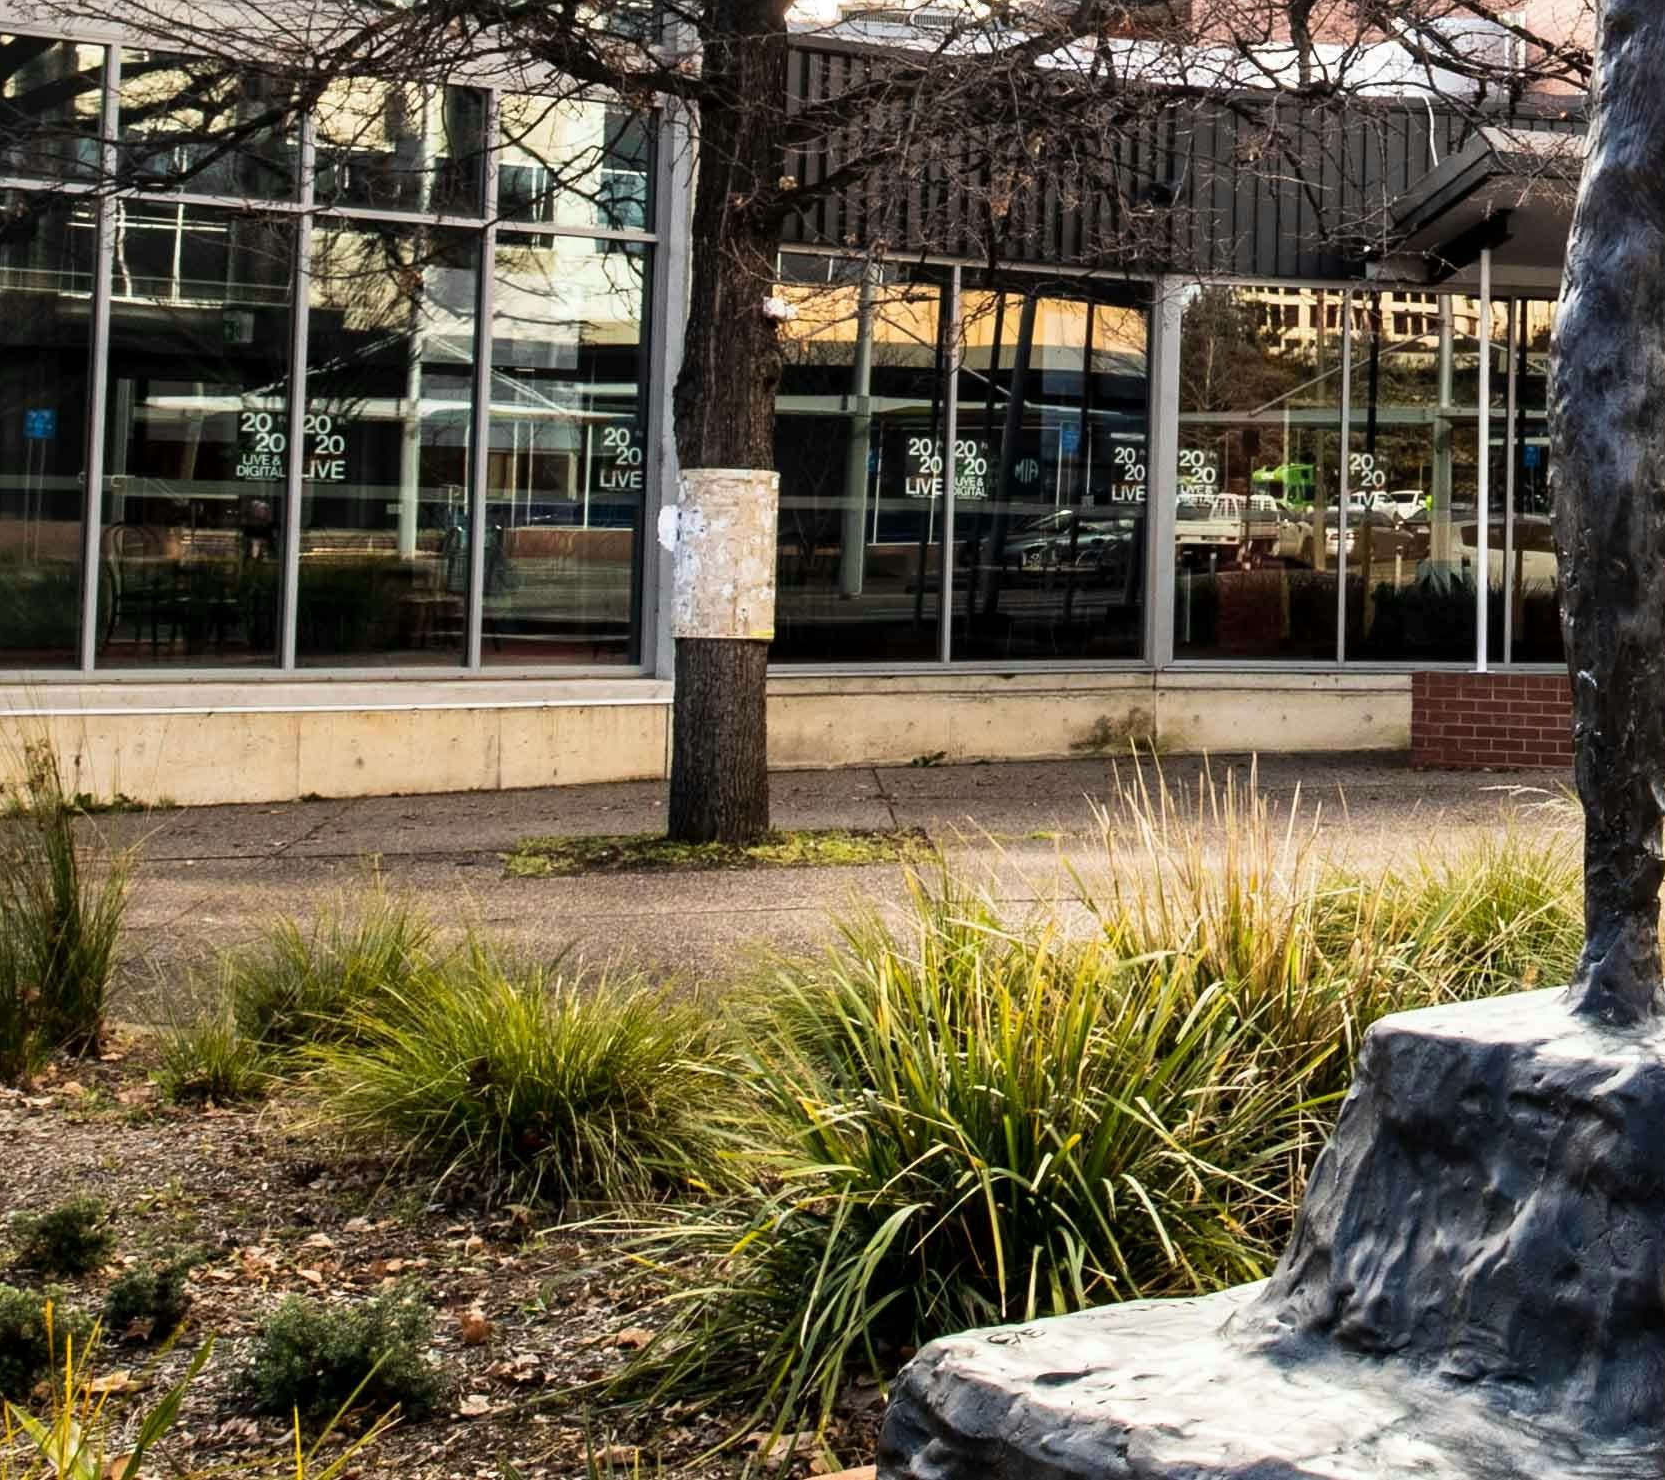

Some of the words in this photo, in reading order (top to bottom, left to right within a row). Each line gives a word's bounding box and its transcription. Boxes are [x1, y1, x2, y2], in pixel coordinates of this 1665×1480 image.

[241, 412, 272, 432] 20
[303, 415, 332, 434] 20
[255, 433, 286, 453] 20
[315, 435, 345, 454] 20
[604, 427, 630, 447] 20
[909, 438, 932, 455] 20
[954, 441, 977, 458] 20
[243, 454, 270, 465] LIVE
[616, 447, 642, 465] 20
[1114, 447, 1136, 464] 20
[1179, 450, 1205, 466] 20
[1349, 453, 1374, 471] 20
[919, 456, 942, 473] 20
[964, 458, 987, 475] 20
[1124, 465, 1146, 481] 20
[599, 470, 642, 488] LIVE
[1191, 467, 1216, 484] 20
[1361, 470, 1385, 488] 20
[905, 477, 943, 495] LIVE
[1111, 485, 1146, 501] LIVE
